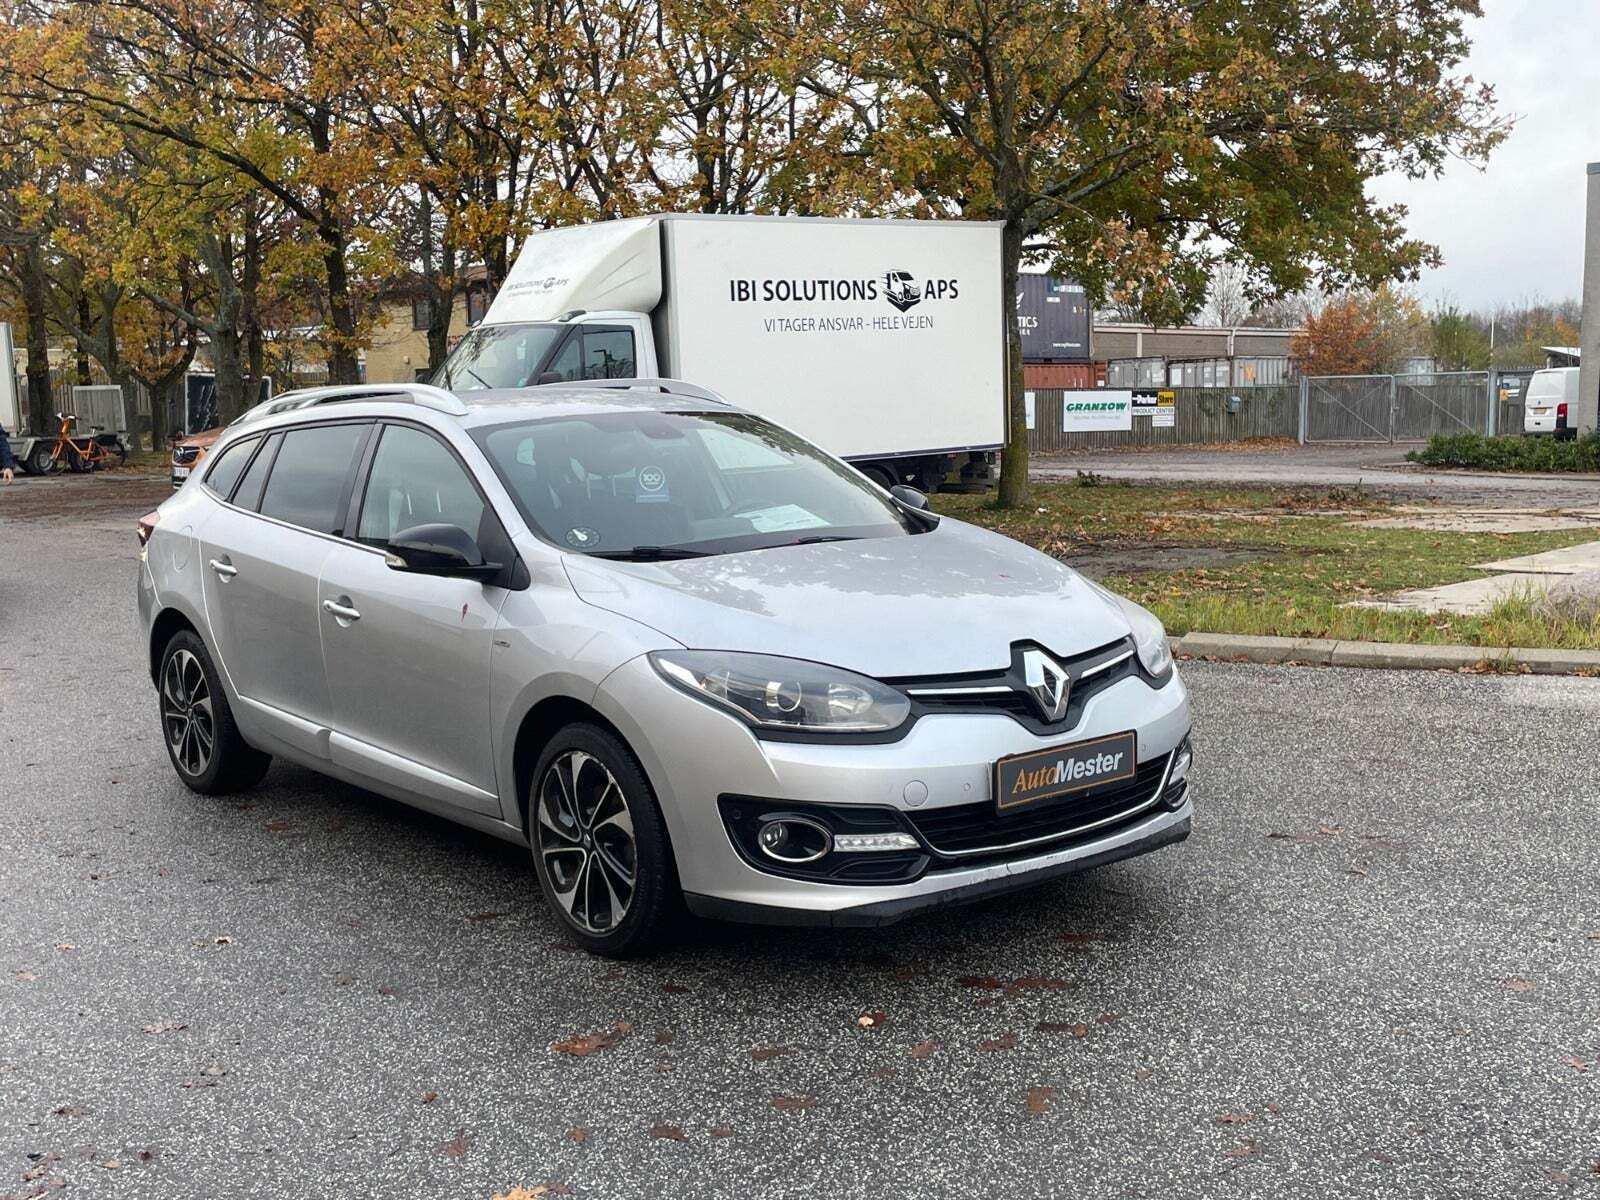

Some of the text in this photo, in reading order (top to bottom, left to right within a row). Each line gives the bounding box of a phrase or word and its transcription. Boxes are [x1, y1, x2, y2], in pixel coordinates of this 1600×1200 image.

[729, 279, 959, 302] IBI SOLUTIONS APS
[764, 318, 776, 332] VI
[777, 318, 816, 332] TAGER
[818, 317, 864, 331] ANSVAR
[872, 316, 899, 330] HELE
[901, 315, 934, 329] VEJEN
[1017, 316, 1038, 328] TICS
[1066, 402, 1128, 412] GRANZOW
[1011, 751, 1124, 794] AutoMester
